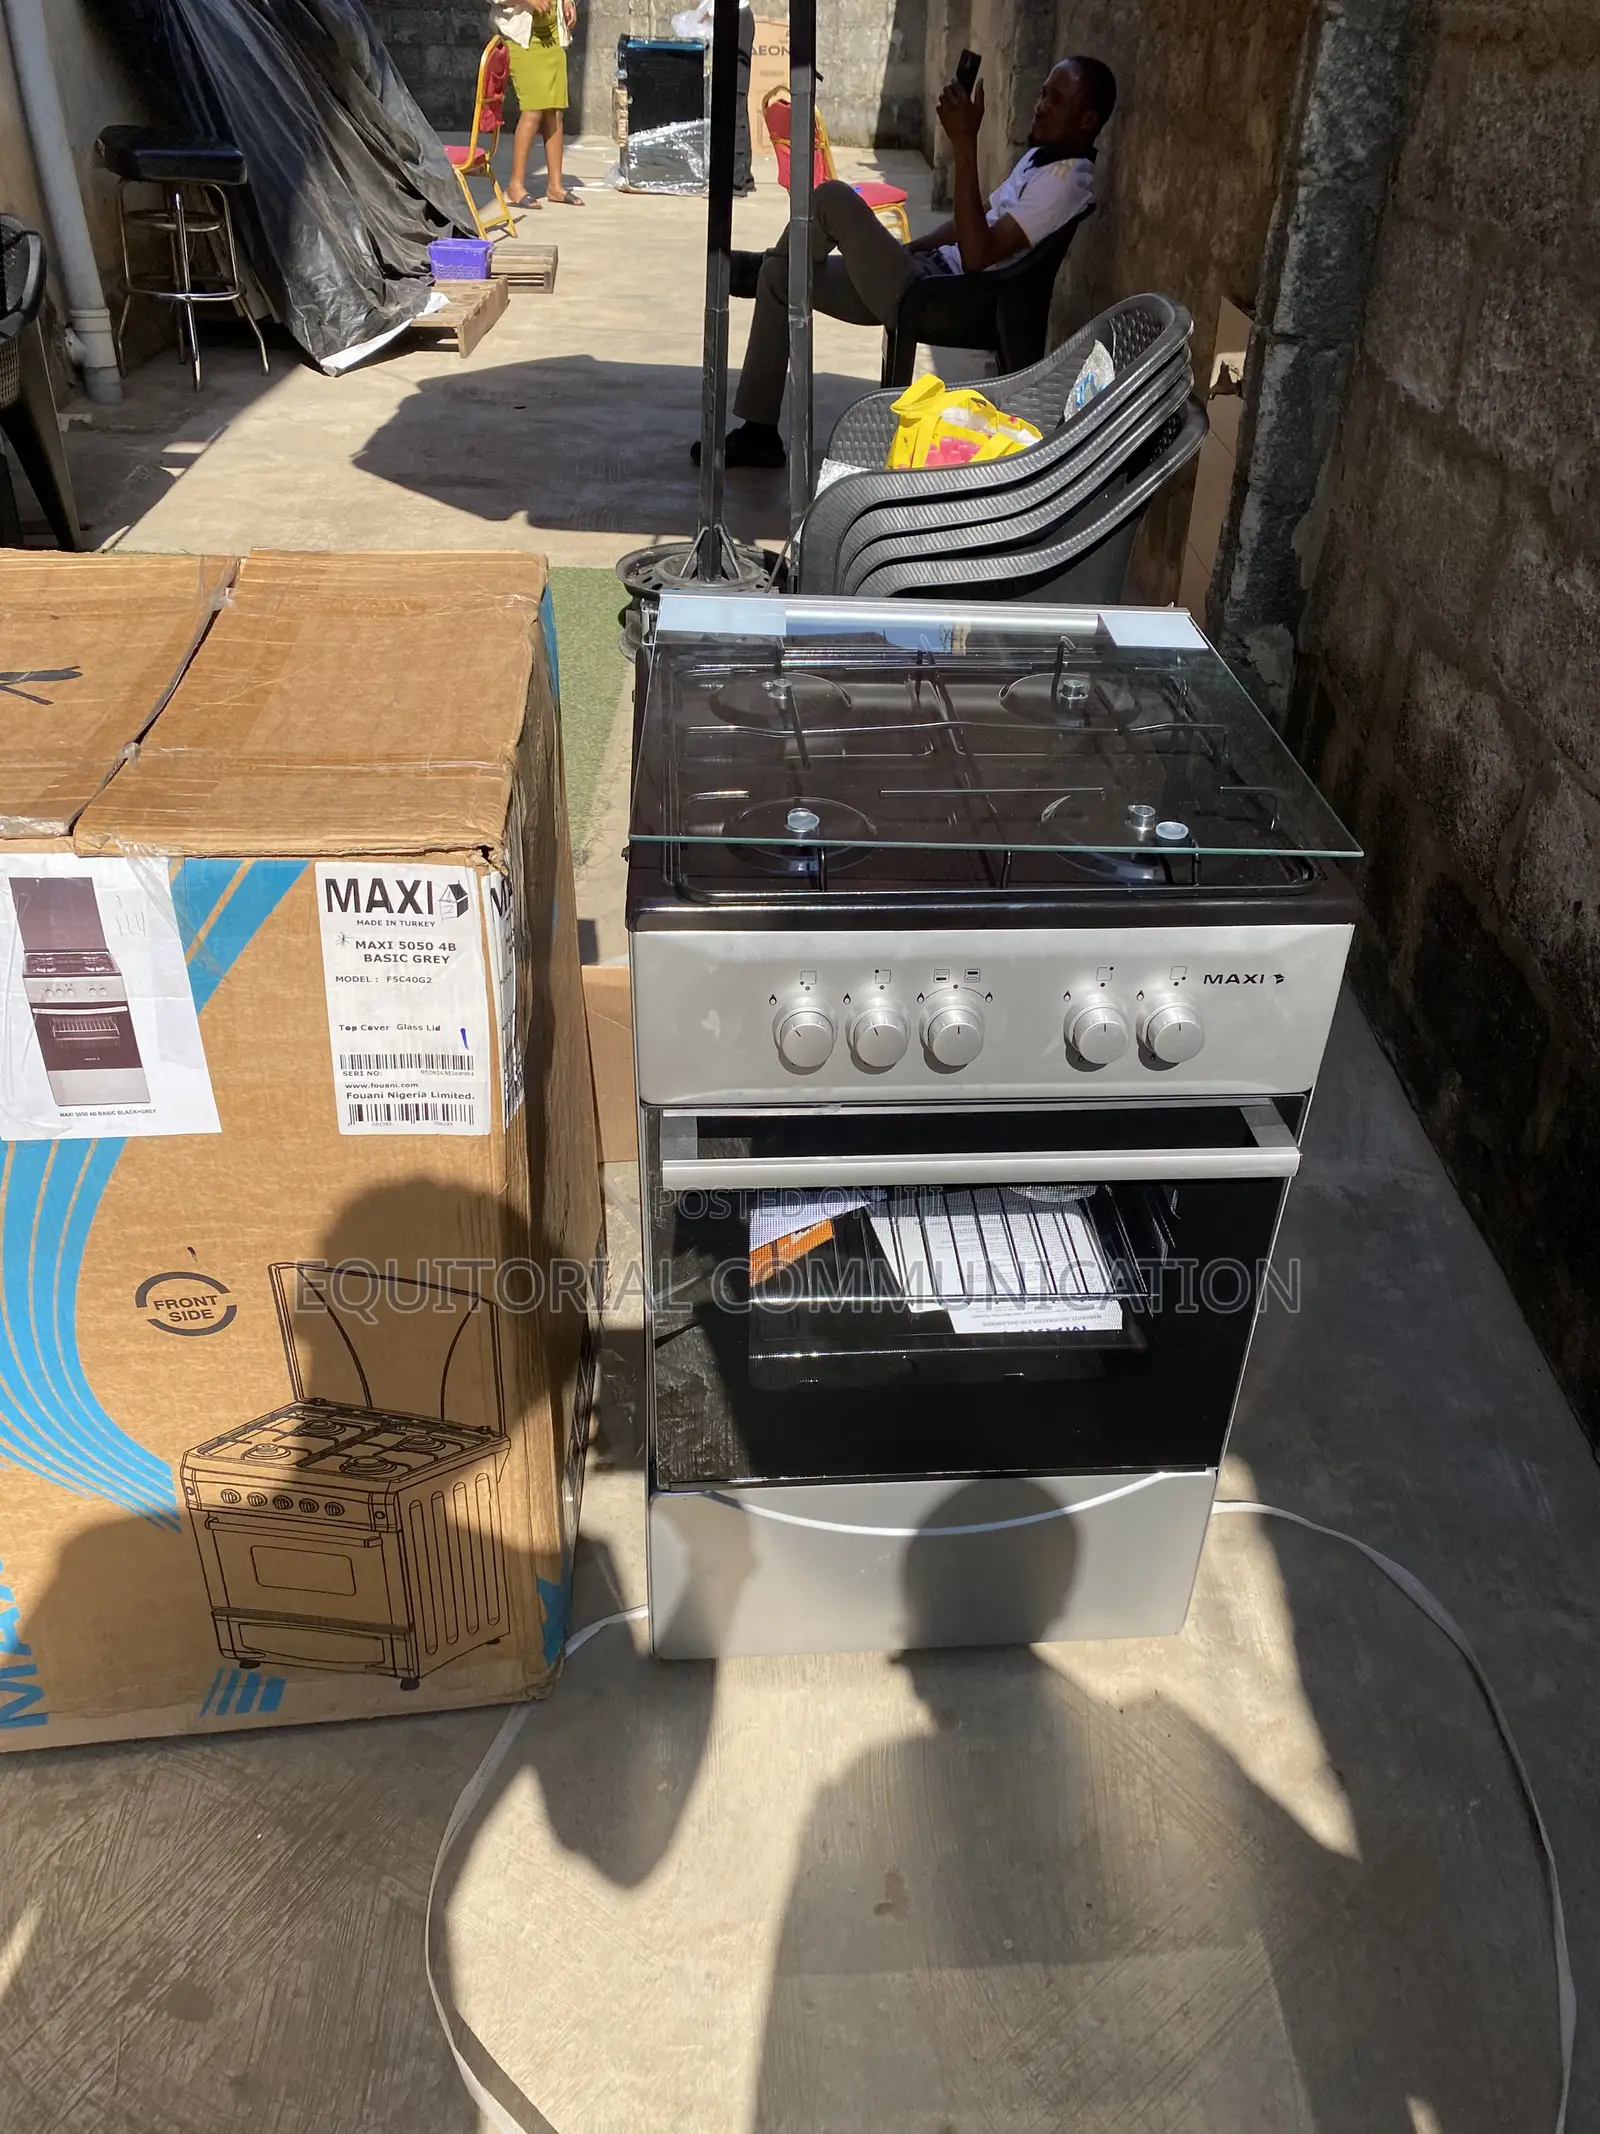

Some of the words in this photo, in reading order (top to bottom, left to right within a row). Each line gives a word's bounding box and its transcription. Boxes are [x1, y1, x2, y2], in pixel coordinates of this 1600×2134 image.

[325, 878, 434, 915] MAXI
[355, 941, 394, 950] MAXI
[398, 941, 434, 951] 5050
[438, 943, 457, 951] 4B
[364, 954, 408, 963] BASIC
[412, 955, 451, 964] GREY
[1203, 974, 1265, 984] MAXI
[339, 1024, 358, 1032] Top
[396, 1023, 424, 1031] Glass
[387, 1091, 428, 1100] Nigeria
[430, 1091, 476, 1100] Limited.
[153, 1295, 218, 1310] FRONT
[168, 1309, 215, 1322] SIDE
